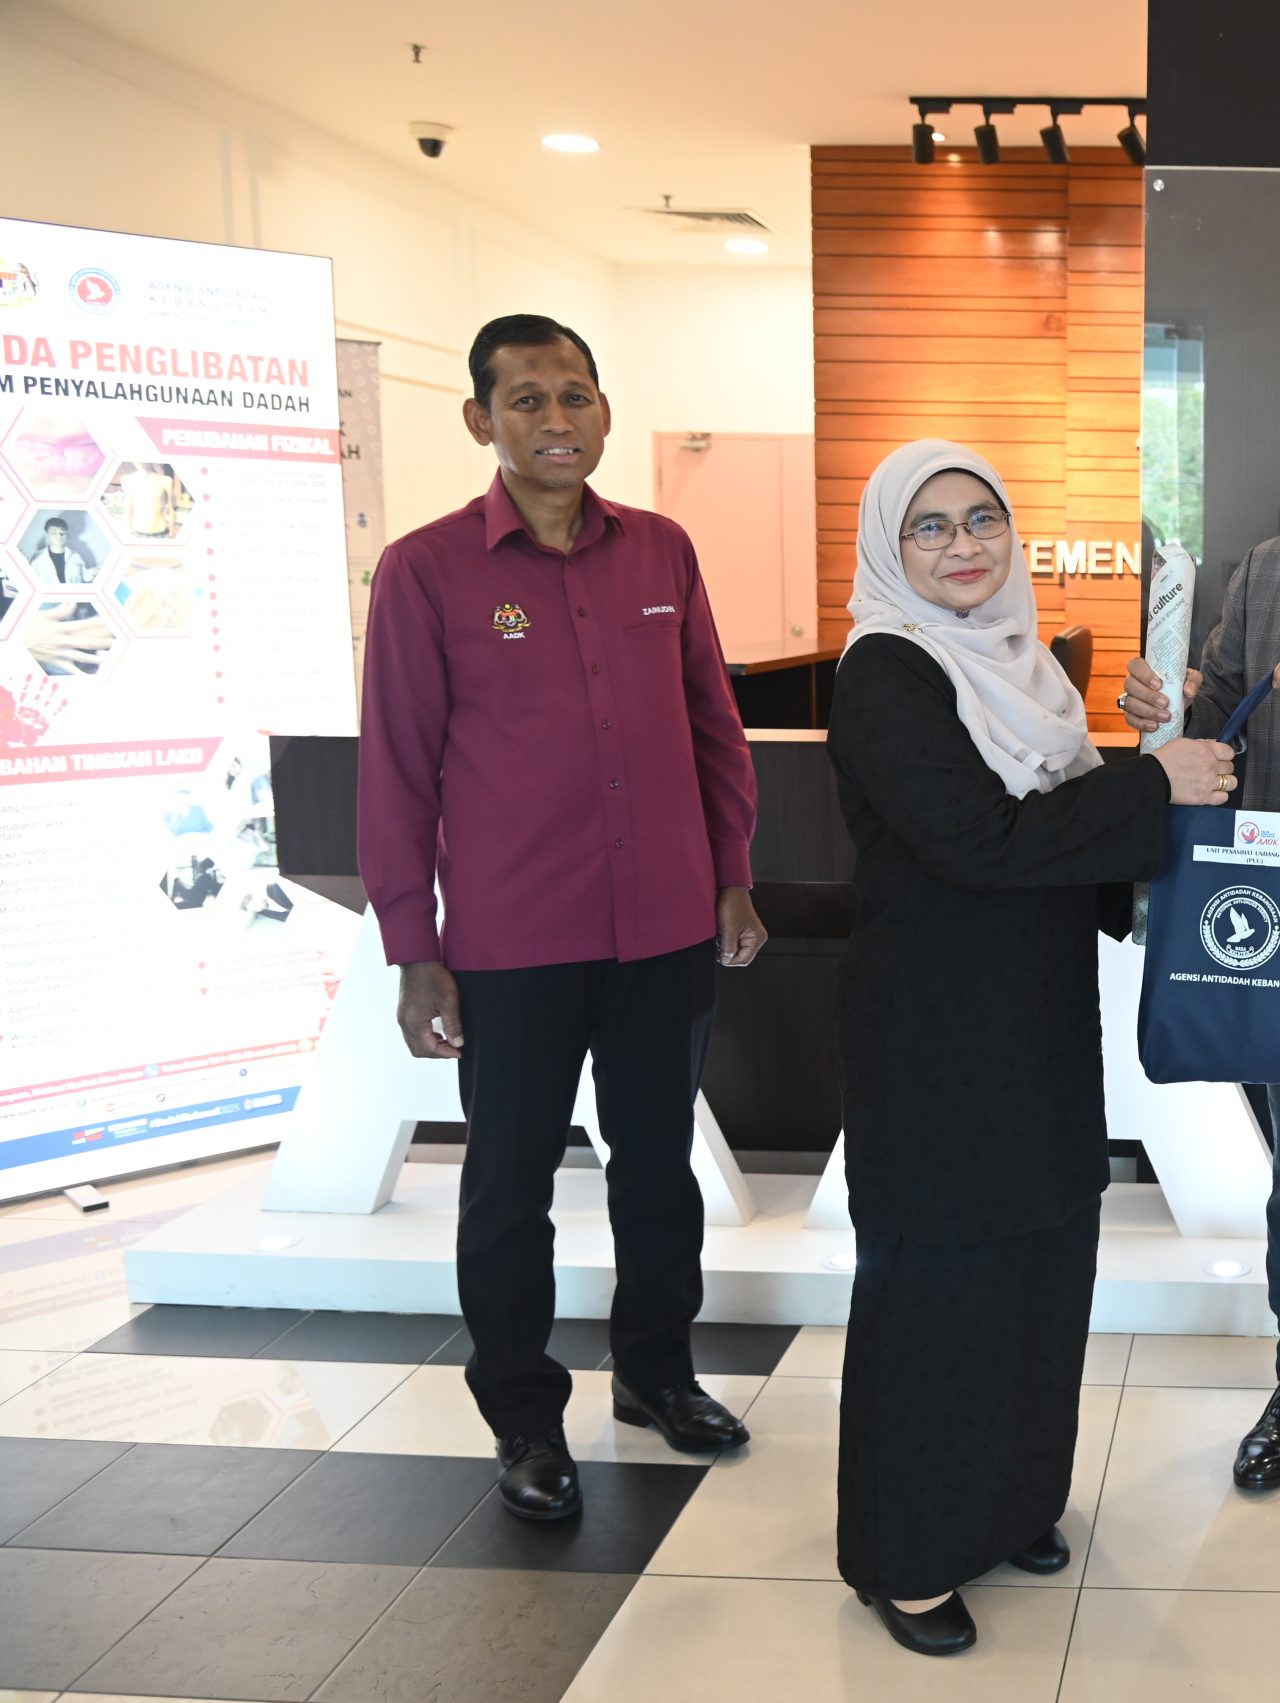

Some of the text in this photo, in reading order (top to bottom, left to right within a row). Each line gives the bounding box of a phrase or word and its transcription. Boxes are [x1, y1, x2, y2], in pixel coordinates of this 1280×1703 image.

[2, 333, 309, 387] DA PENGLIBATAN
[0, 374, 310, 413] M PENYALAHGUNAAN DADAH
[161, 428, 335, 456] PERUBAHAN FIZIKAL
[1022, 540, 1142, 575] EMEN
[1152, 583, 1184, 615] culture
[0, 747, 204, 776] BAHAN TINGKAH LAKU
[1256, 838, 1279, 846] AADK
[1206, 889, 1279, 923] AGENSI ANTIDADAH KEBANGSAAN
[1169, 972, 1200, 982] AGENSI
[1202, 974, 1250, 986] ANTIDADAH
